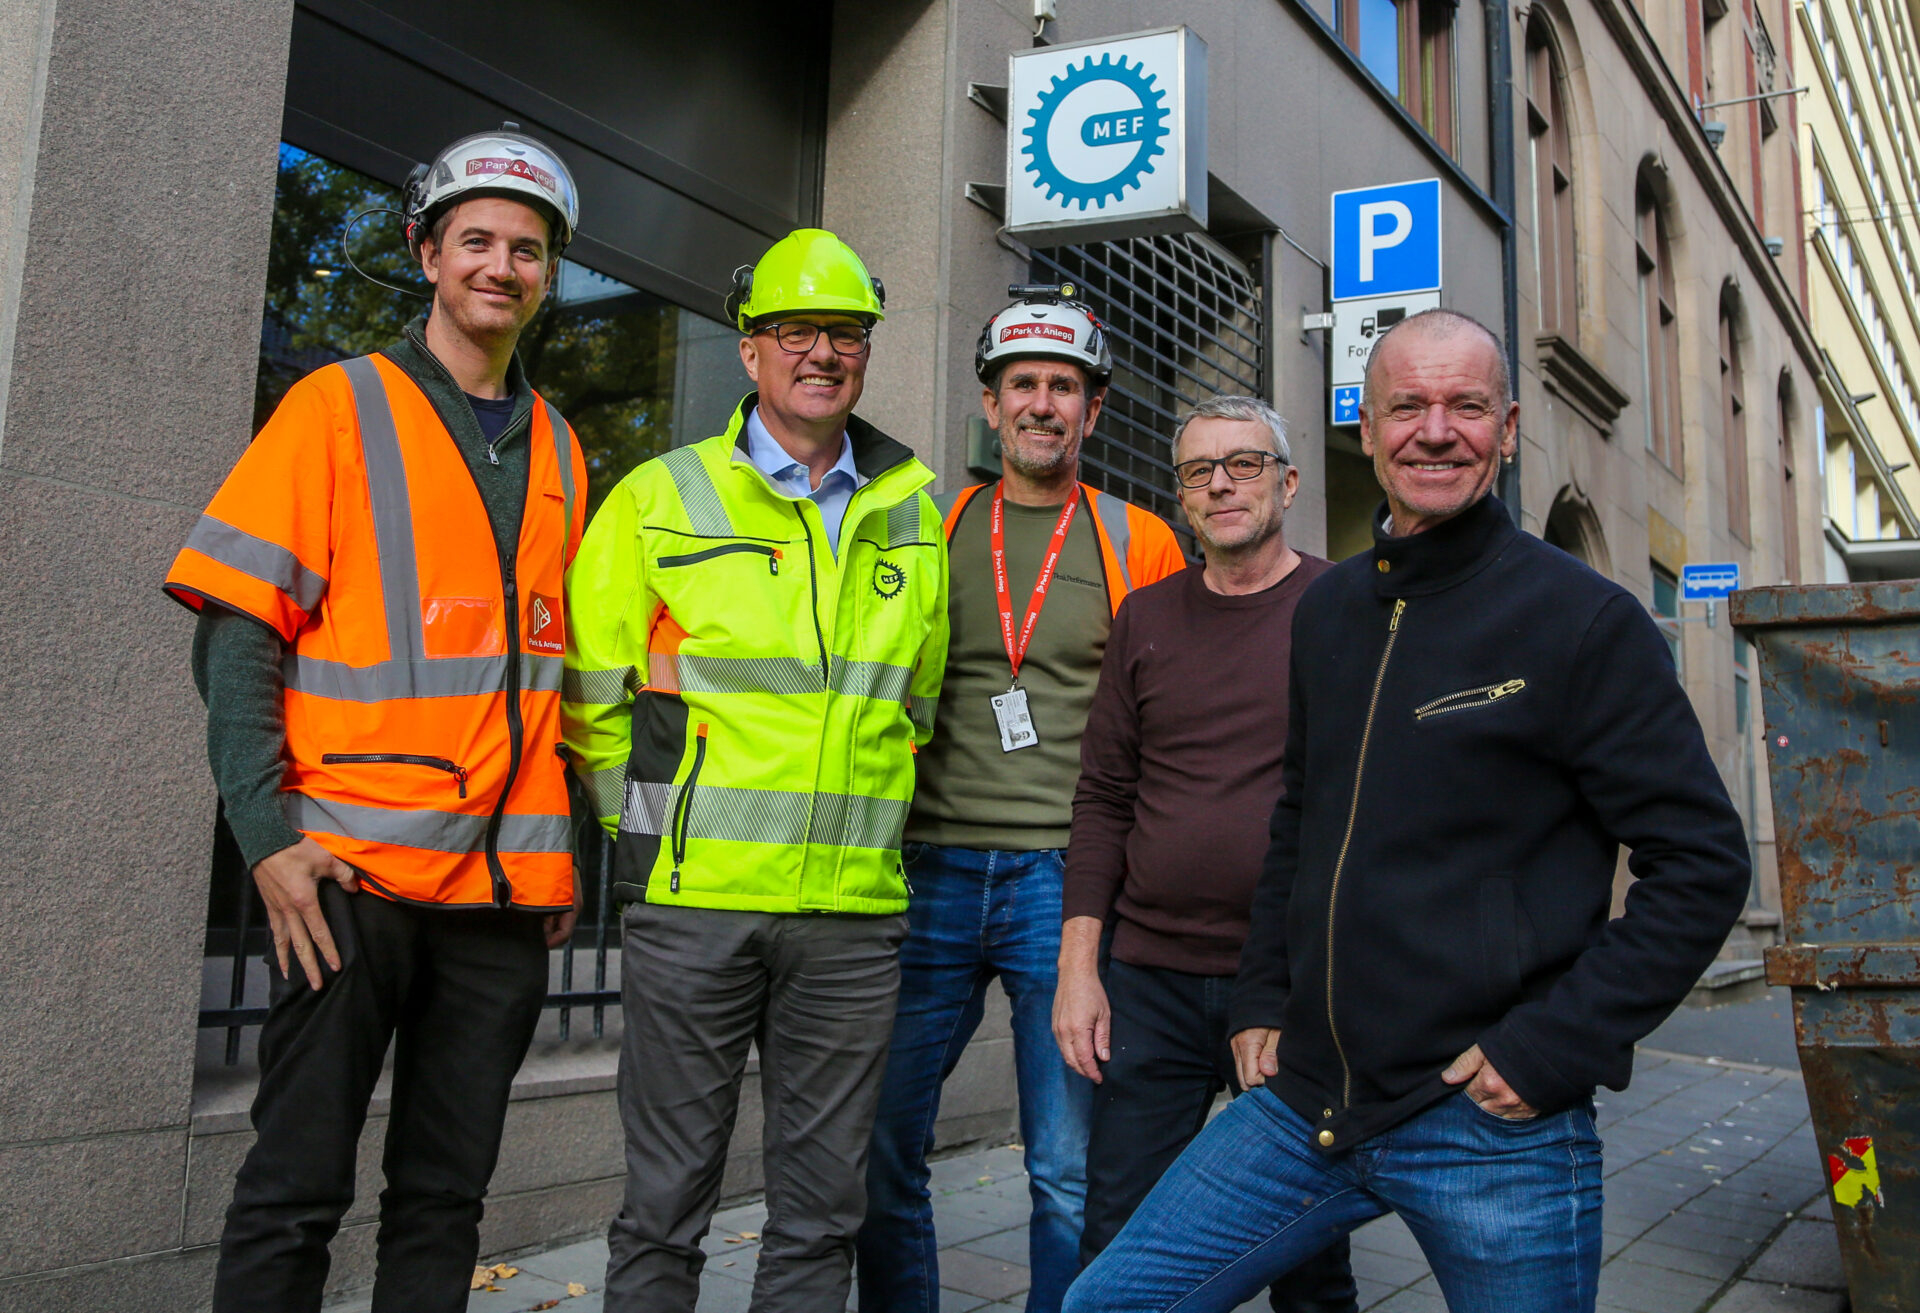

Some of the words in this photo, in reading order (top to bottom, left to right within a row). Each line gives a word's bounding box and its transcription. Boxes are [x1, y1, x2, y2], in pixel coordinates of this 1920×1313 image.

[1093, 116, 1144, 139] MEF
[486, 161, 509, 169] Park
[513, 164, 521, 172] &
[524, 167, 554, 188] Alegg
[1359, 200, 1413, 282] P
[1013, 326, 1032, 336] Park
[1034, 326, 1041, 334] &
[1043, 327, 1072, 341] Anlegg
[1348, 345, 1369, 358] For
[1345, 409, 1351, 418] P
[1040, 574, 1048, 585] Park
[529, 638, 538, 646] Park
[544, 641, 562, 651] Anlegg
